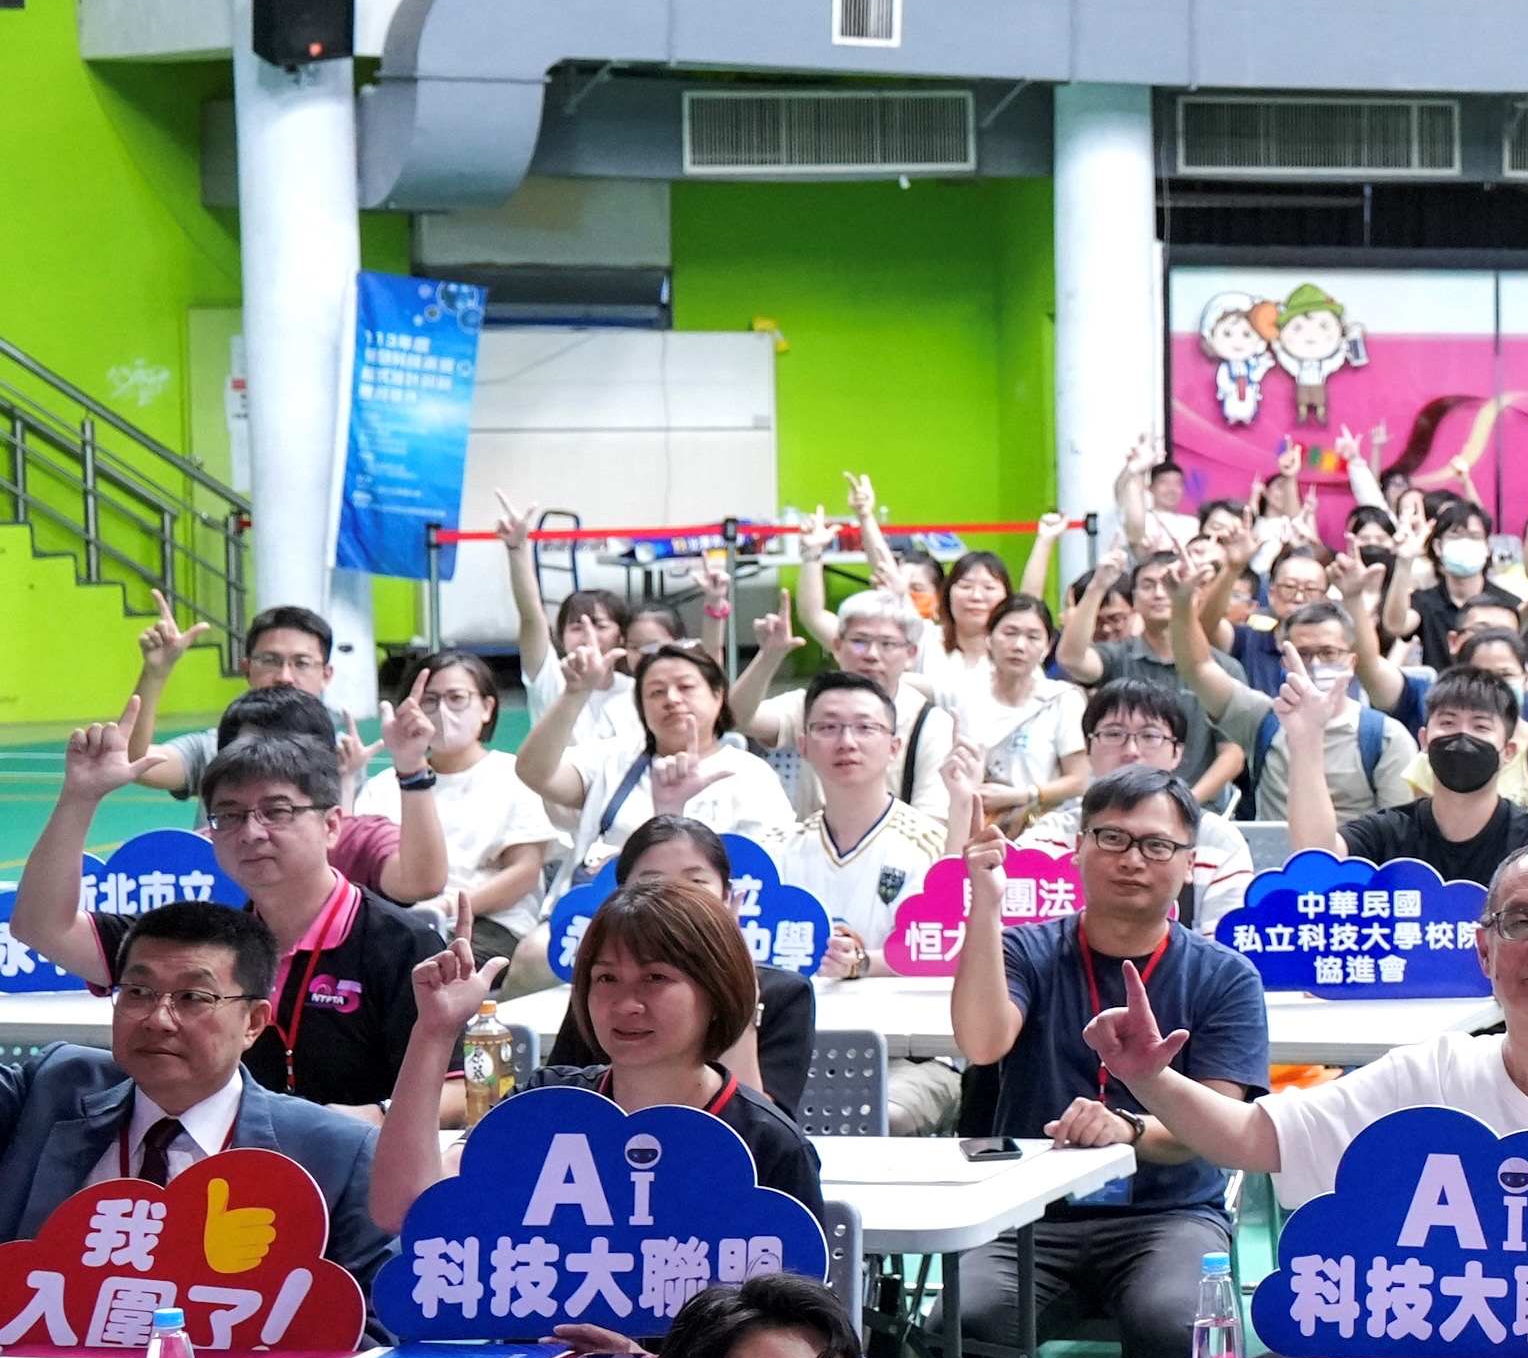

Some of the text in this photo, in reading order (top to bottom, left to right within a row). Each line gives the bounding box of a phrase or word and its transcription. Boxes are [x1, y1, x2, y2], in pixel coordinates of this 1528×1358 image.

[962, 877, 1076, 917] 團法
[1297, 889, 1422, 920] 中華民國
[1232, 921, 1482, 953] 私立科技大學校院
[1314, 954, 1408, 985] 協進會
[82, 1198, 167, 1274] 我
